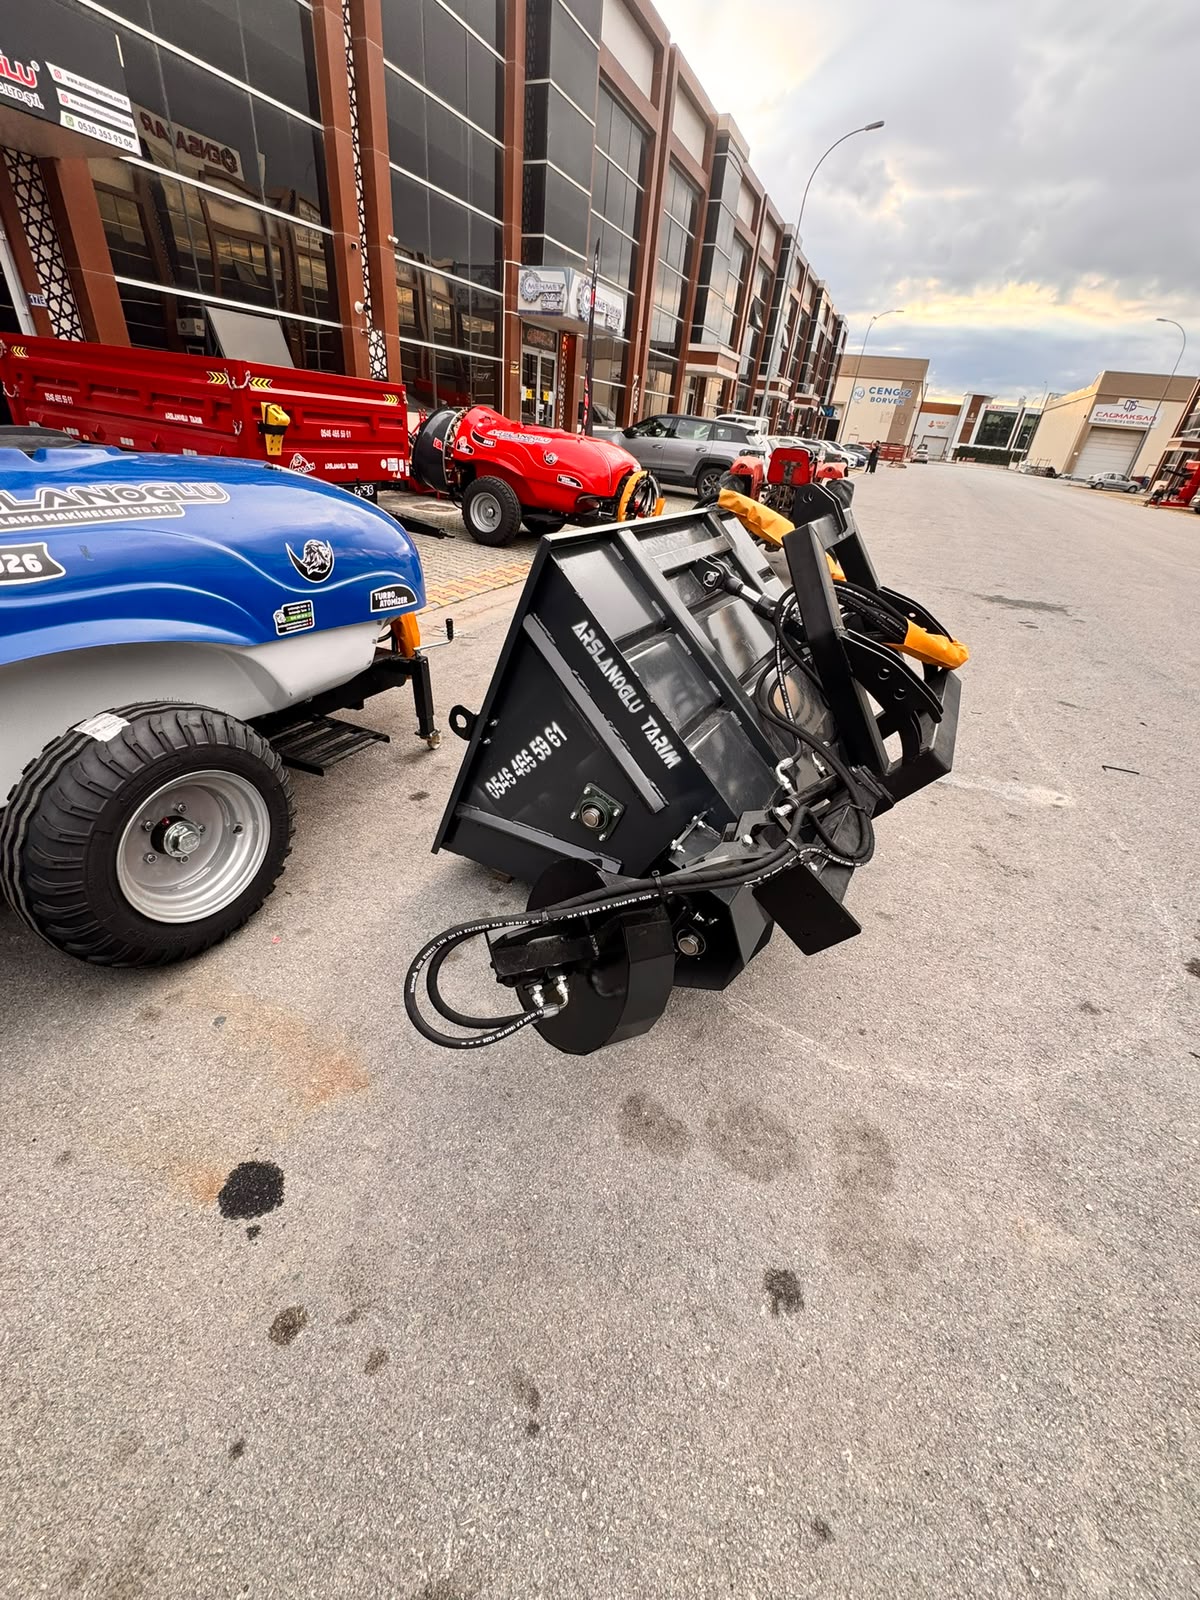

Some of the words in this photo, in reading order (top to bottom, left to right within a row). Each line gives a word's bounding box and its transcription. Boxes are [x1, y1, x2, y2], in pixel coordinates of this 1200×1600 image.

[77, 120, 97, 135] 0530
[98, 128, 112, 141] 353
[113, 134, 123, 145] 93
[123, 138, 133, 148] 06
[0, 483, 229, 513] LANOGLU
[43, 505, 128, 521] MAKİNELERİ
[374, 590, 396, 601] TURBO
[379, 595, 408, 608] ATOMİZER
[571, 620, 645, 714] ARSLANOGLU
[640, 714, 682, 770] TARIM
[485, 767, 517, 799] 0546
[529, 735, 552, 761] 59
[544, 720, 568, 748] 61
